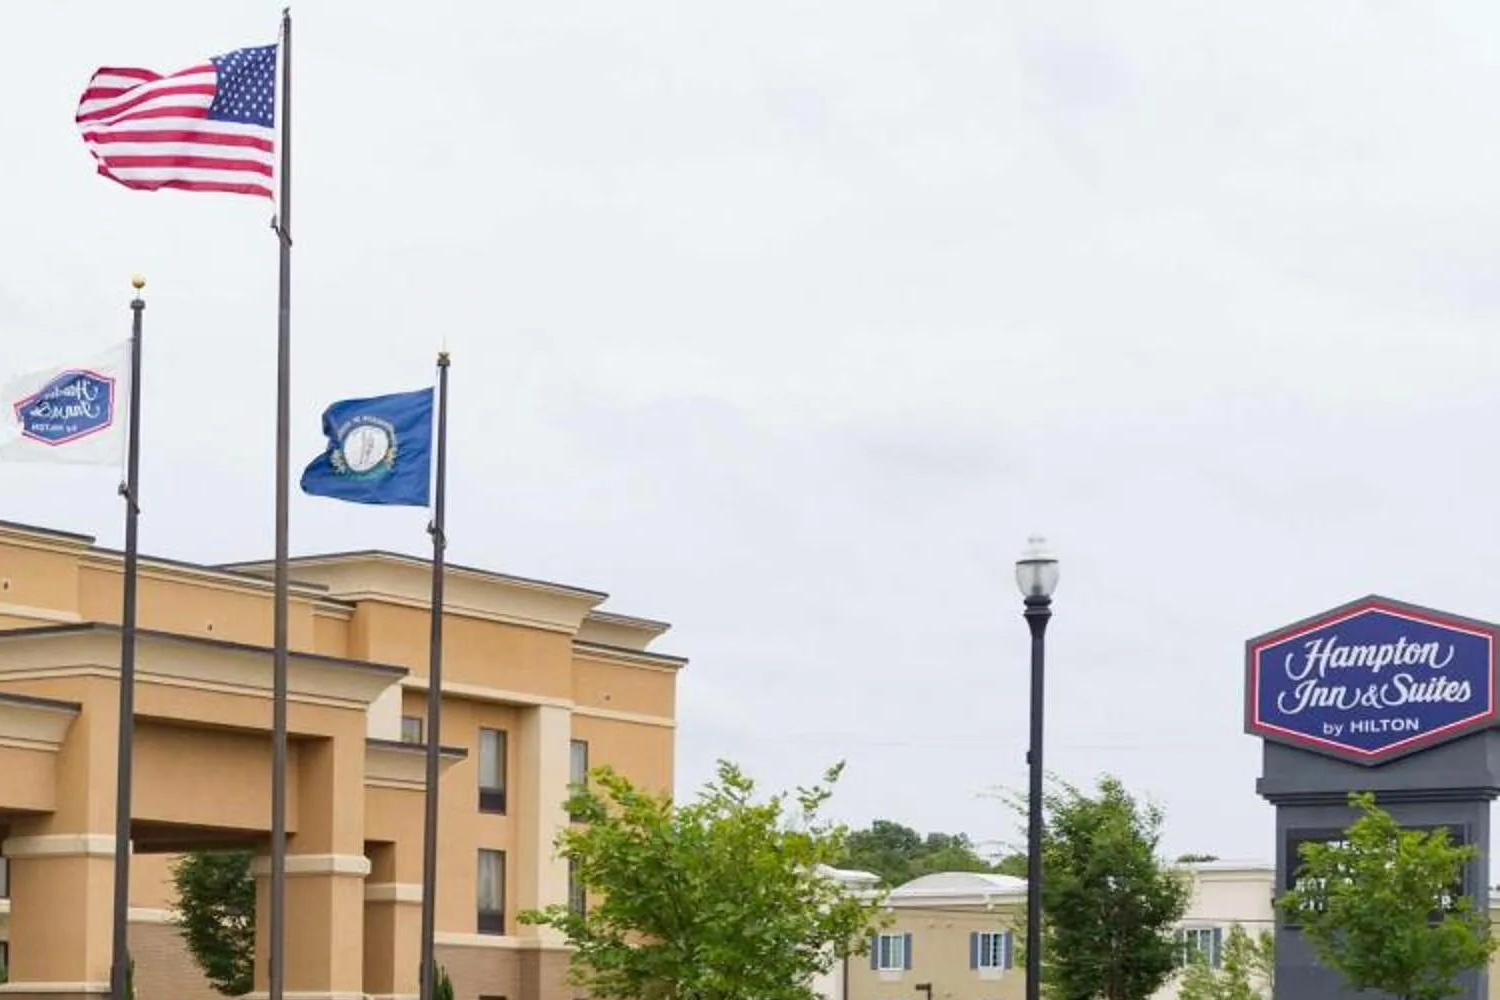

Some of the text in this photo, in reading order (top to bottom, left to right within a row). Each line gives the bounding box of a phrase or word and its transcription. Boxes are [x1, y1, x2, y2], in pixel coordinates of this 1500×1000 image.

[1285, 635, 1455, 681] Hampton
[1277, 673, 1472, 714] Inn & Suites
[1323, 717, 1420, 736] by HILTON
